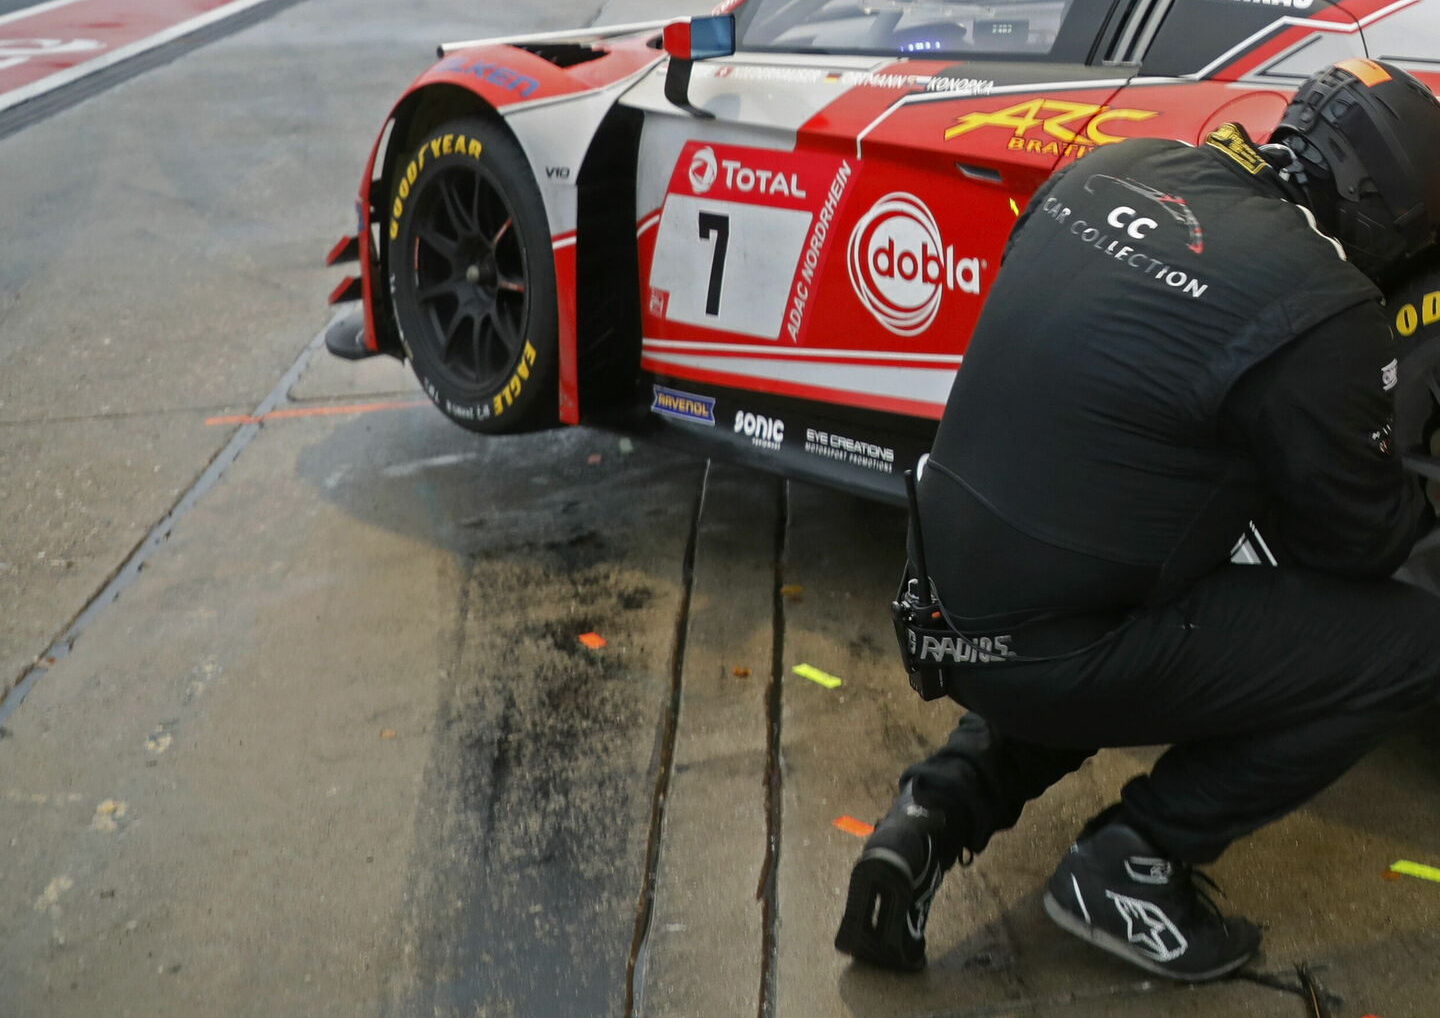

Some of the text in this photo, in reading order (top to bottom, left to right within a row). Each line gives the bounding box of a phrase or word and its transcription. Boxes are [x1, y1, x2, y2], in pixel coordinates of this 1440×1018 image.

[545, 166, 571, 180] V10
[722, 159, 807, 199] TOTAL
[1106, 206, 1159, 240] CC
[698, 210, 730, 317] 7
[787, 159, 852, 343] ADAC NORDRHEIN
[872, 235, 981, 295] dobla
[1043, 197, 1209, 299] CAR COLLECTION
[493, 339, 537, 417] EAGLE
[657, 392, 710, 418] RAVENOL
[733, 410, 785, 443] SONIC
[804, 441, 848, 463] MOTORSPORT
[848, 453, 893, 475] PROMOTIONS
[806, 428, 829, 445] EYE
[829, 433, 895, 463] CREATIONS
[920, 634, 1013, 664] RADIOS
